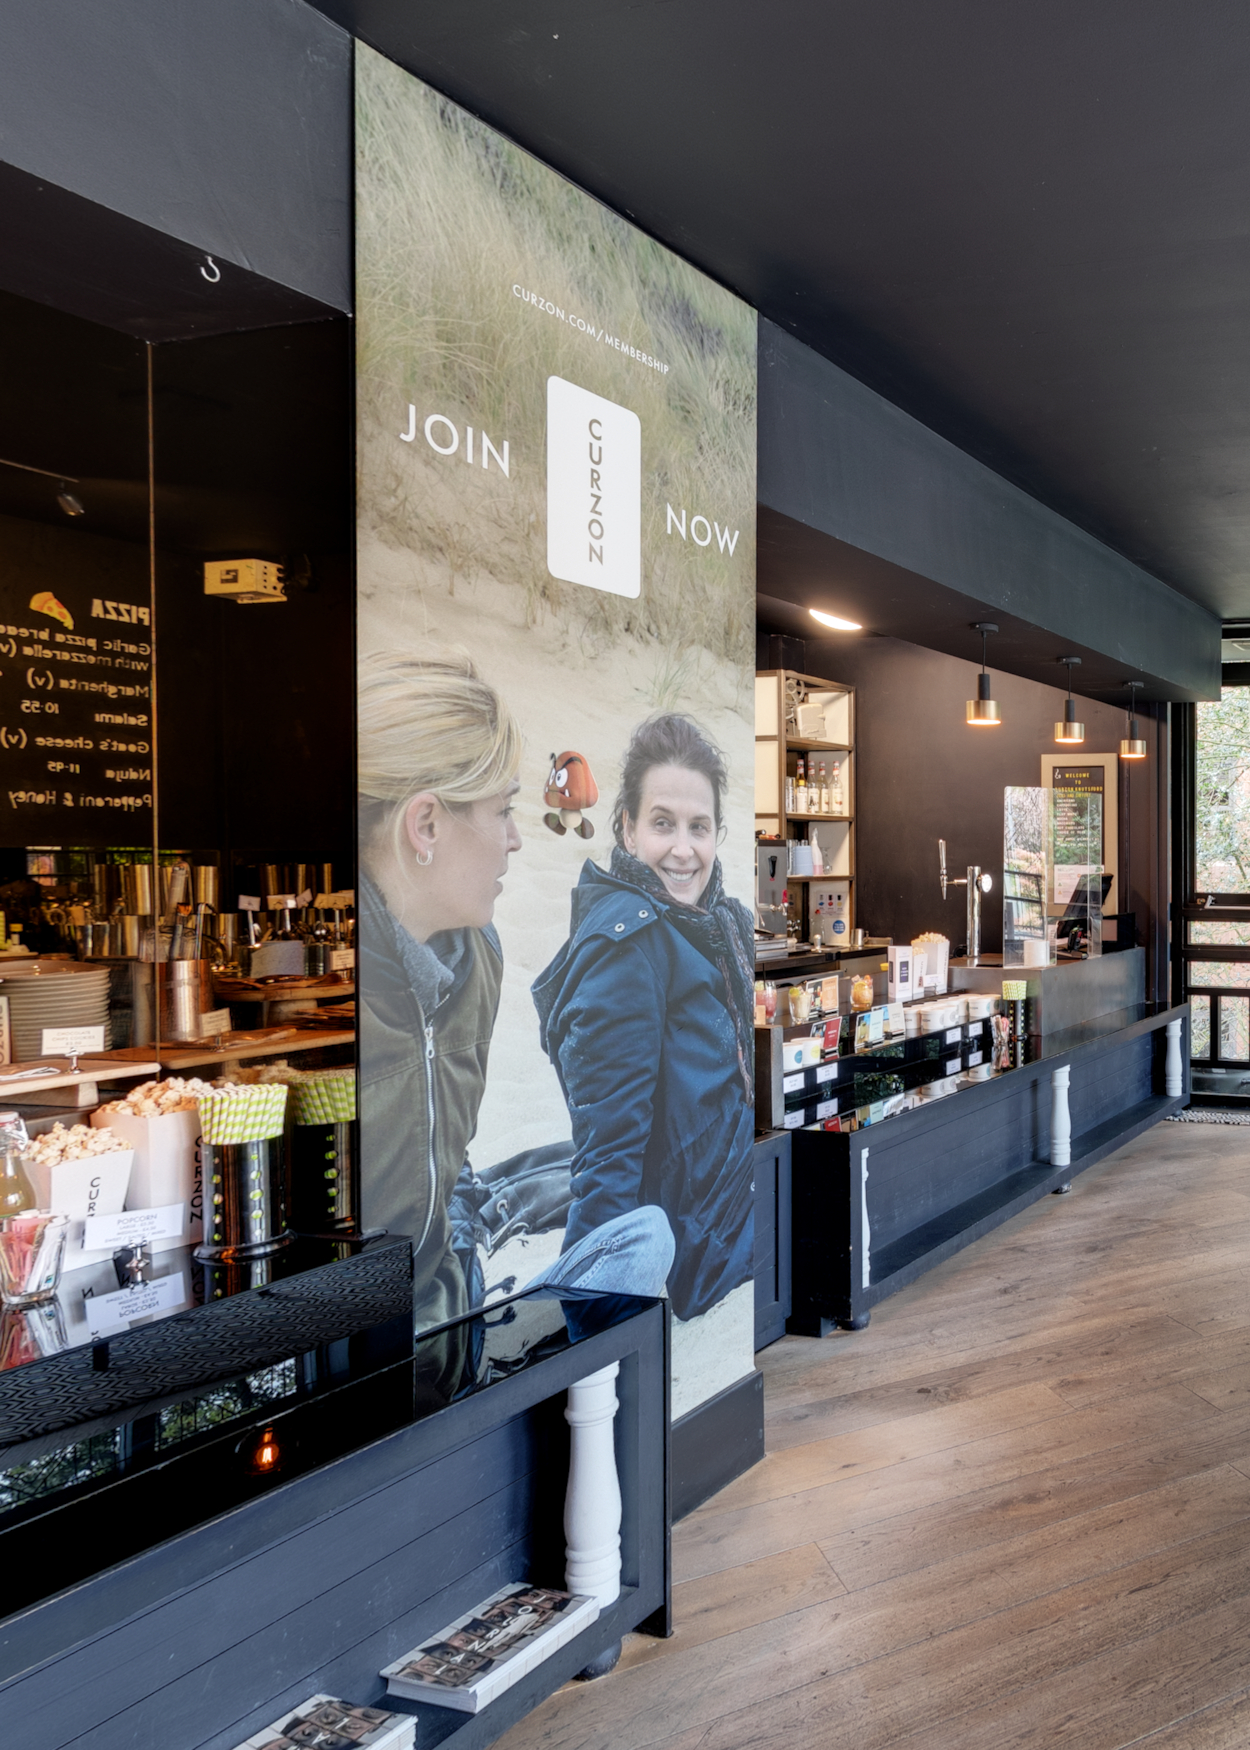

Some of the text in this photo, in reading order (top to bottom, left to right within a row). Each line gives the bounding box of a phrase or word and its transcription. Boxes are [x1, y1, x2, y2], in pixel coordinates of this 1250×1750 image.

[512, 284, 669, 375] CURZON.COM/MEMBERSHIP
[399, 403, 510, 479] JOIN
[588, 418, 605, 567] CURZON
[667, 502, 740, 557] NOW
[117, 1213, 158, 1226] POPCORN
